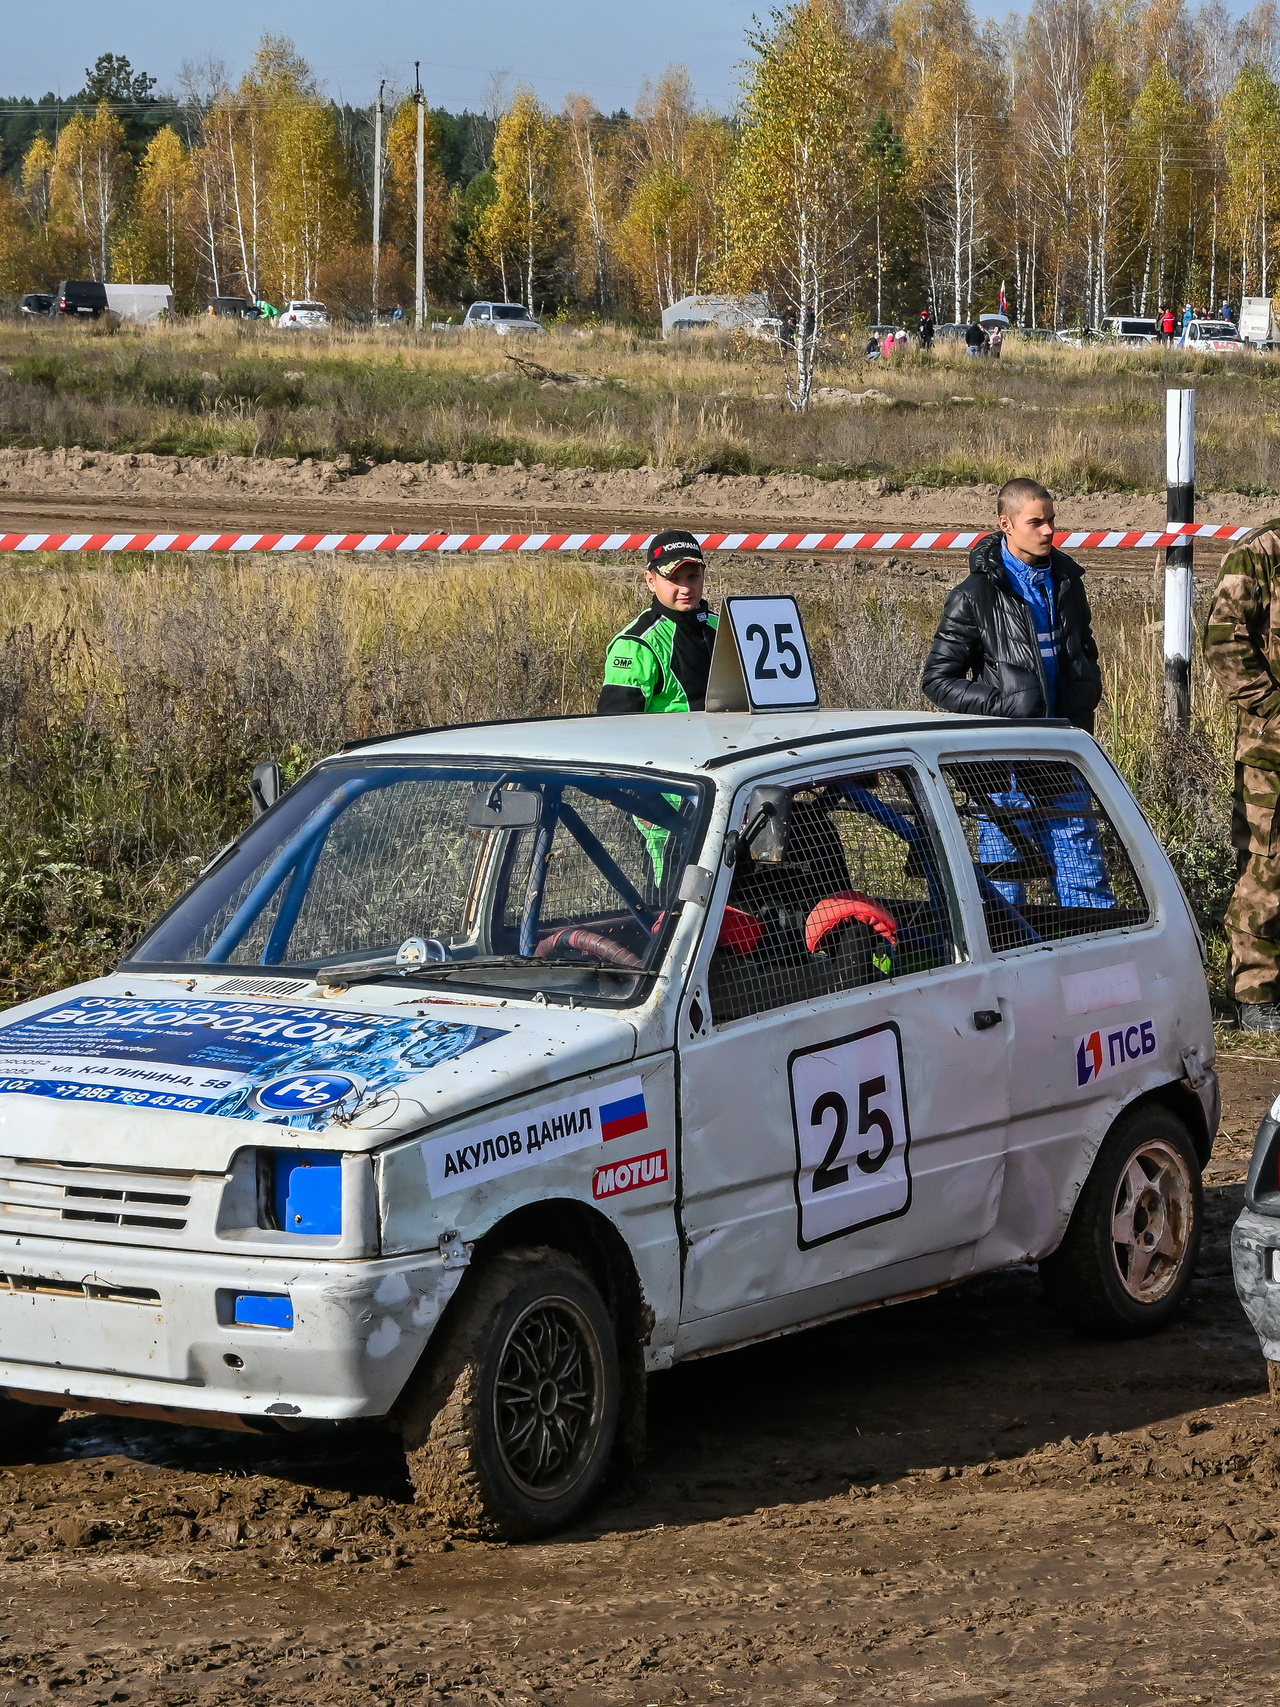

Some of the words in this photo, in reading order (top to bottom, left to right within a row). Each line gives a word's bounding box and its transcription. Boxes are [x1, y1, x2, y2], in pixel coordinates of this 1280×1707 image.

[663, 541, 699, 552] YOKOHAMA
[613, 658, 633, 667] OMP
[746, 623, 802, 680] 25
[36, 1009, 378, 1045] ВОДОРОДОМ
[80, 998, 210, 1011] ОЧИСТКА
[215, 1002, 402, 1027] ДВИГАТЕЛЯ
[1107, 1019, 1157, 1067] ПСБ
[78, 1065, 195, 1087] КАЛИНИНА,
[199, 1079, 232, 1089] 58
[75, 1086, 115, 1100] 986
[112, 1090, 151, 1104] 769
[147, 1094, 173, 1106] 43
[172, 1098, 203, 1110] 46
[444, 1131, 523, 1179] АКУЛОВ
[526, 1107, 593, 1154] ДАНИЛ
[810, 1074, 895, 1194] 25
[596, 1155, 666, 1196] MOTUL
